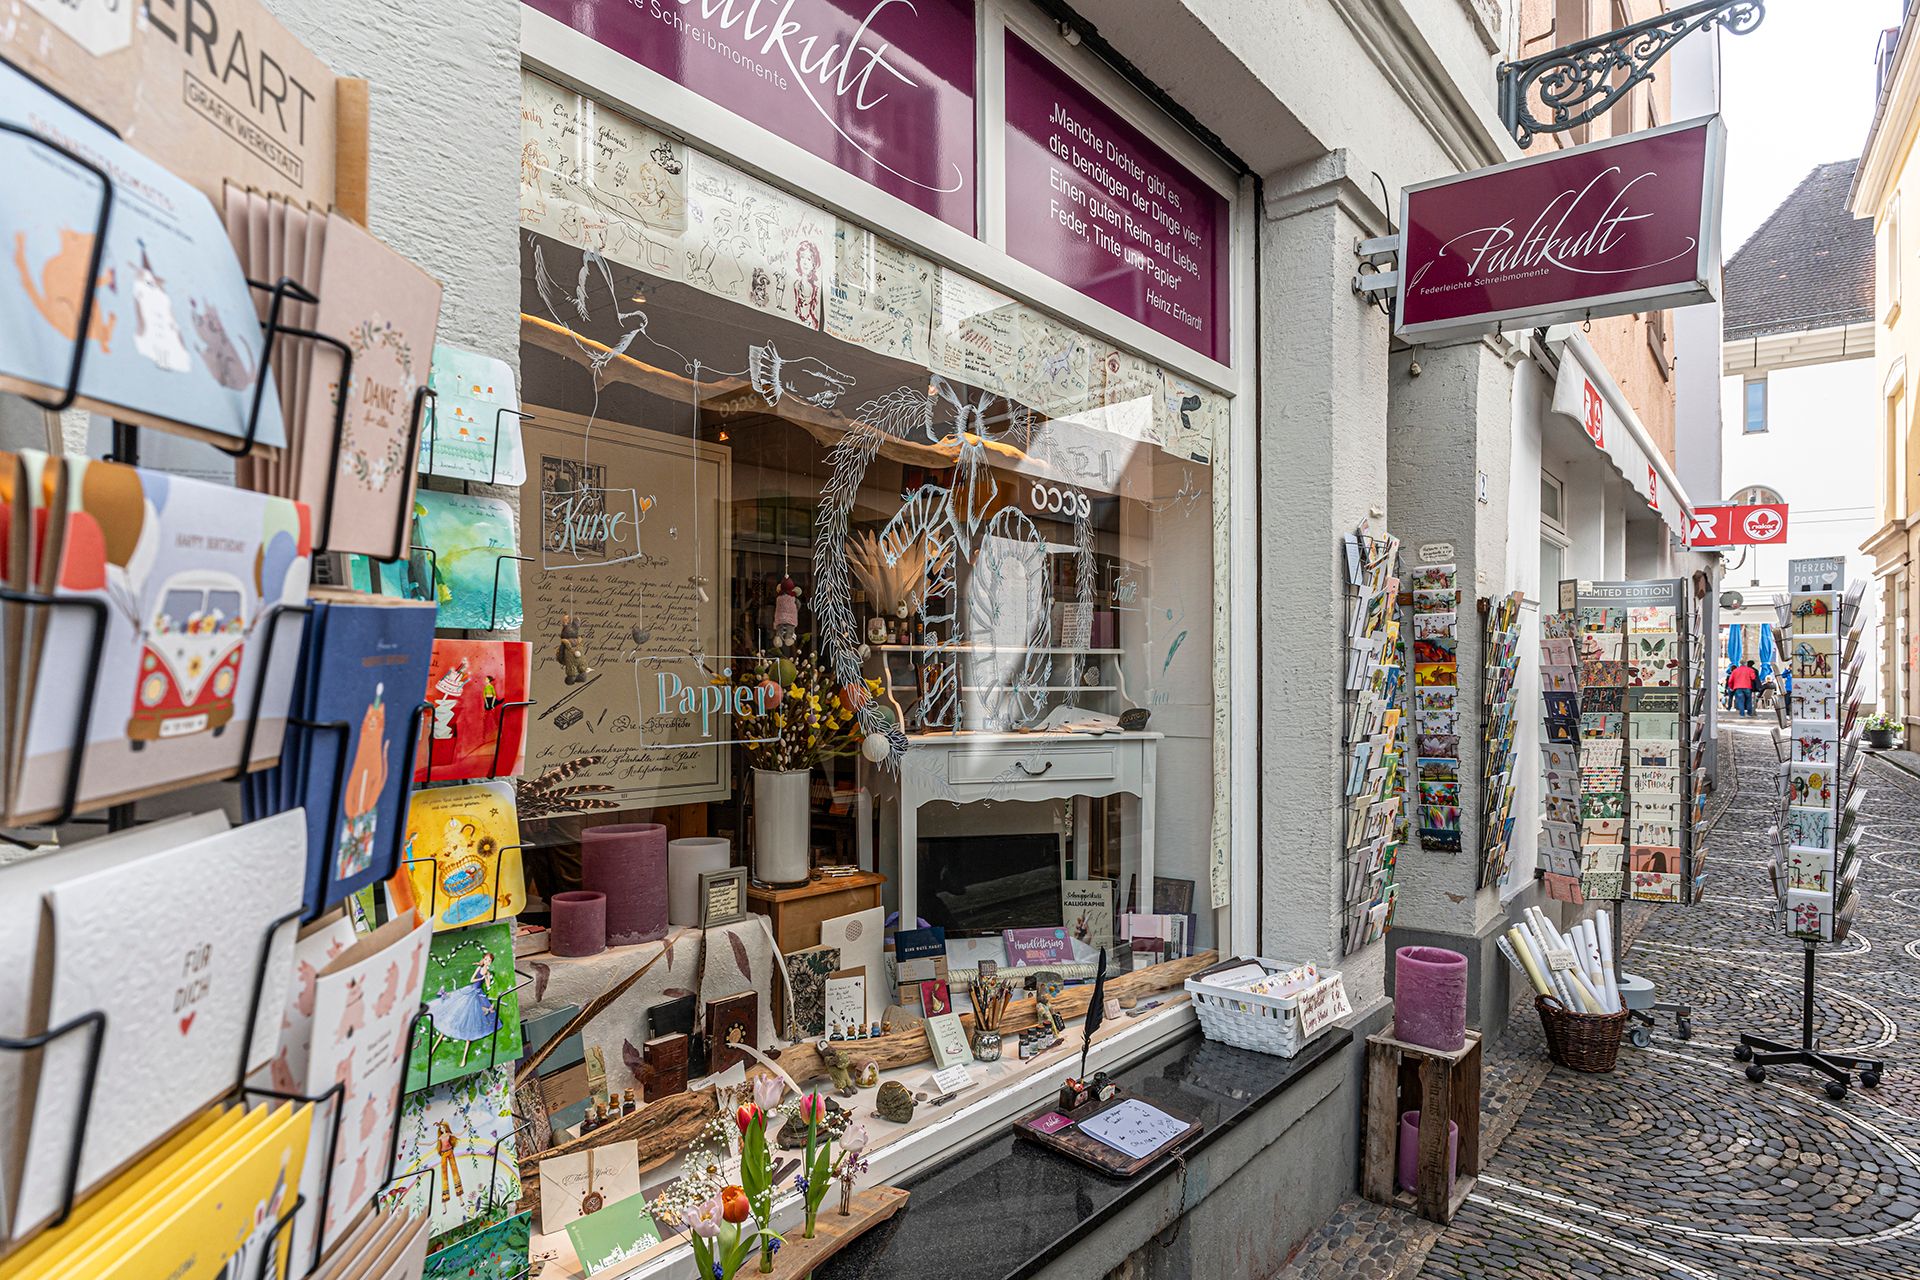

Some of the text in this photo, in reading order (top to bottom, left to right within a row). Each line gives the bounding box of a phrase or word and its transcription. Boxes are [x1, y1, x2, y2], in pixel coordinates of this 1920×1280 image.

[649, 2, 788, 91] Schreibmomente
[188, 82, 234, 132] GRAFIK
[237, 119, 300, 178] WERKSTATT
[1050, 103, 1183, 213] „Manche Dichter gibt es,
[1050, 135, 1202, 250] die benötigen der Dinge vier:
[1050, 168, 1200, 280] Einen guten Reim auf Liebe,
[1050, 199, 1090, 243] Feder,
[1093, 224, 1122, 257] Tinte
[1124, 247, 1144, 271] und
[1420, 266, 1550, 296] Federleichte Schreibmomente
[1146, 288, 1202, 332] Heinz Erhardt
[363, 376, 398, 415] DANKE
[550, 493, 628, 562] Kurse
[1794, 562, 1838, 573] HERZENS
[1794, 574, 1820, 585] POST
[1625, 587, 1670, 597] EDITION
[656, 668, 775, 738] Papier
[182, 941, 213, 978] FÜR
[1014, 937, 1065, 951] Handlettering
[173, 973, 212, 1014] DICH
